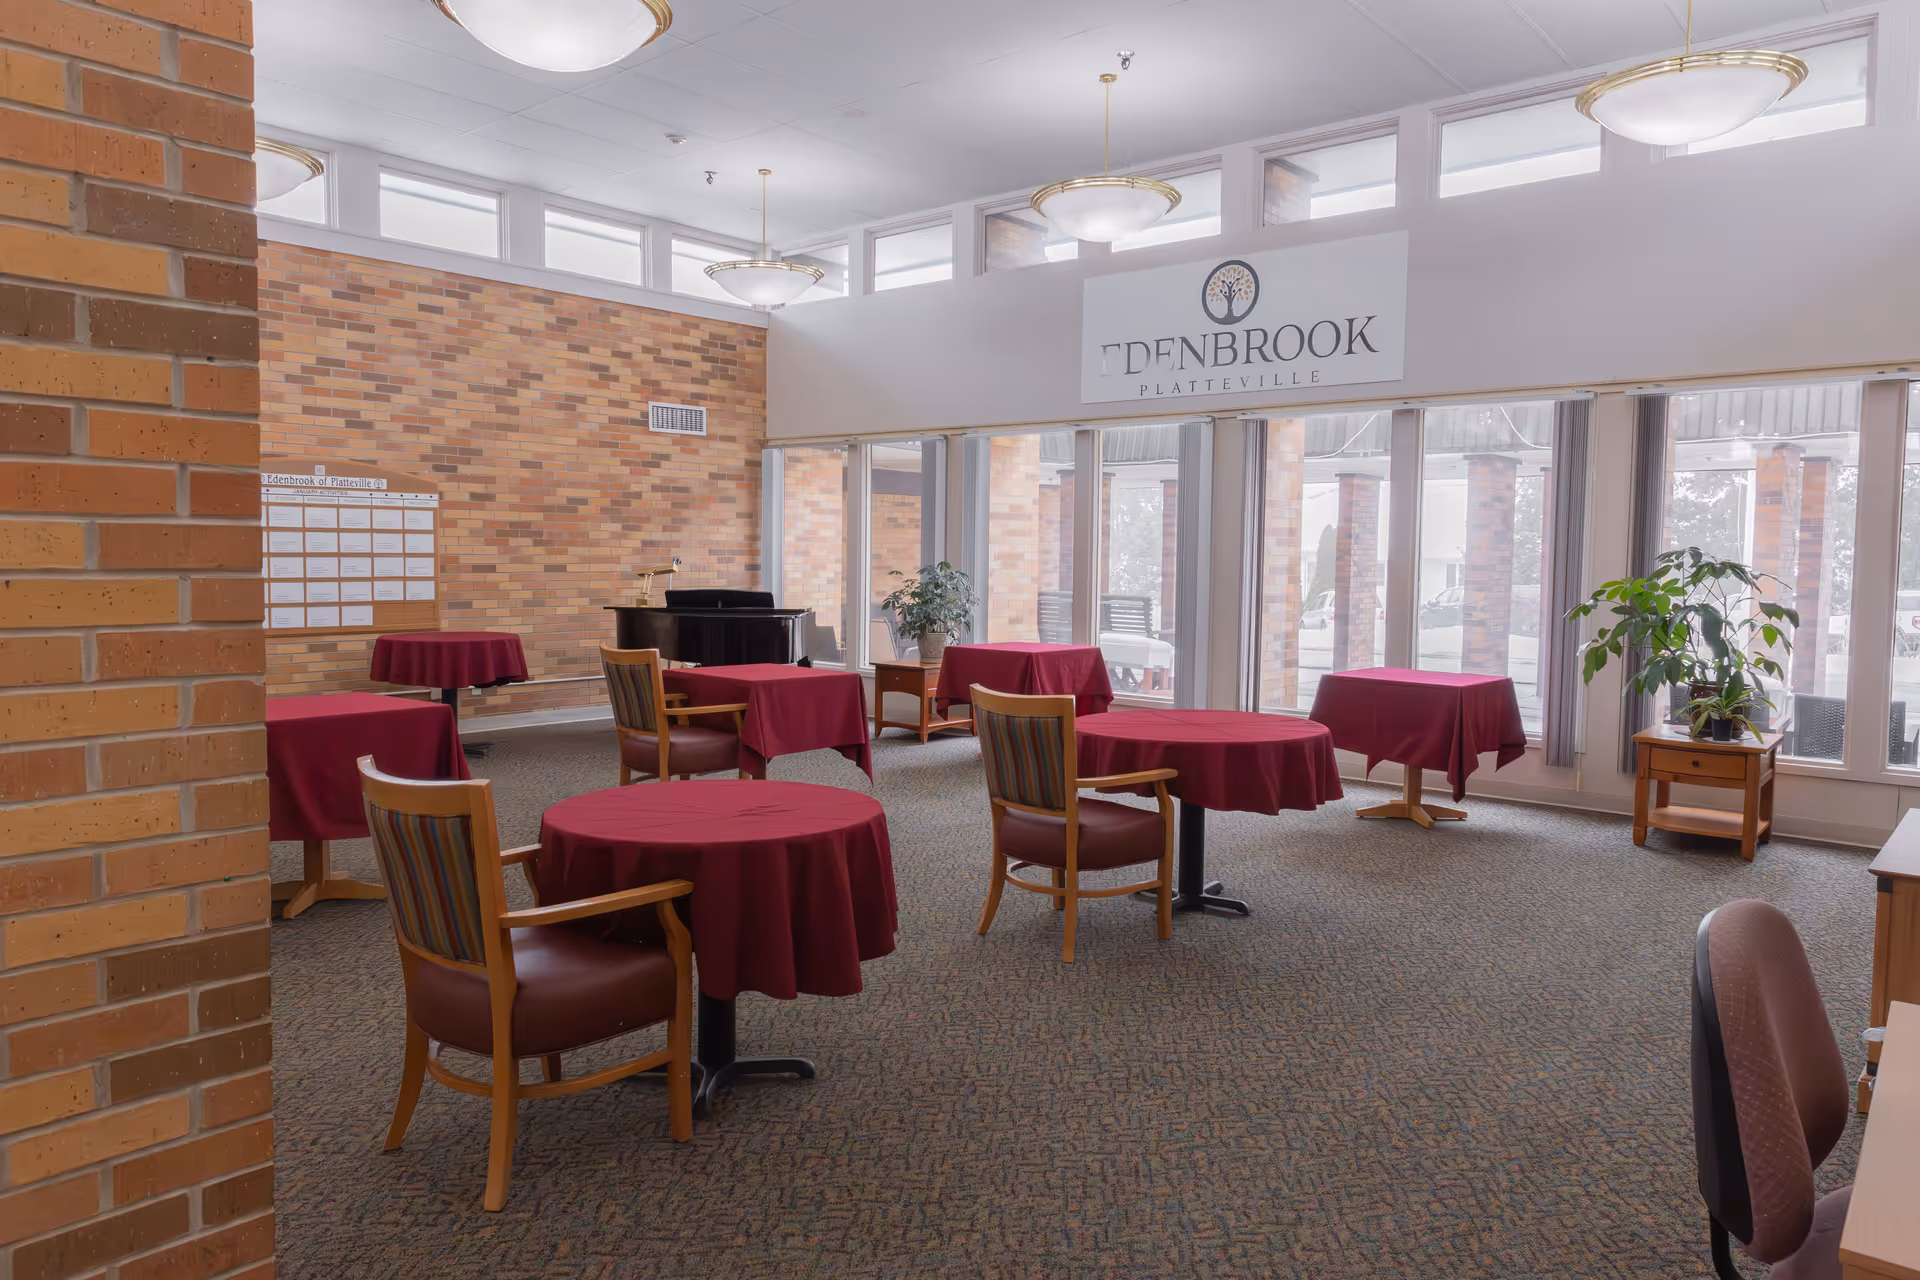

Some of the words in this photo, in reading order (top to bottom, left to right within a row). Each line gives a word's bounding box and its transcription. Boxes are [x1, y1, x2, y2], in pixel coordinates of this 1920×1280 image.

[1140, 370, 1321, 396] PLATTEVILLE
[267, 474, 315, 486] Edenbrook
[319, 476, 328, 486] of
[331, 477, 372, 488] Platteville
